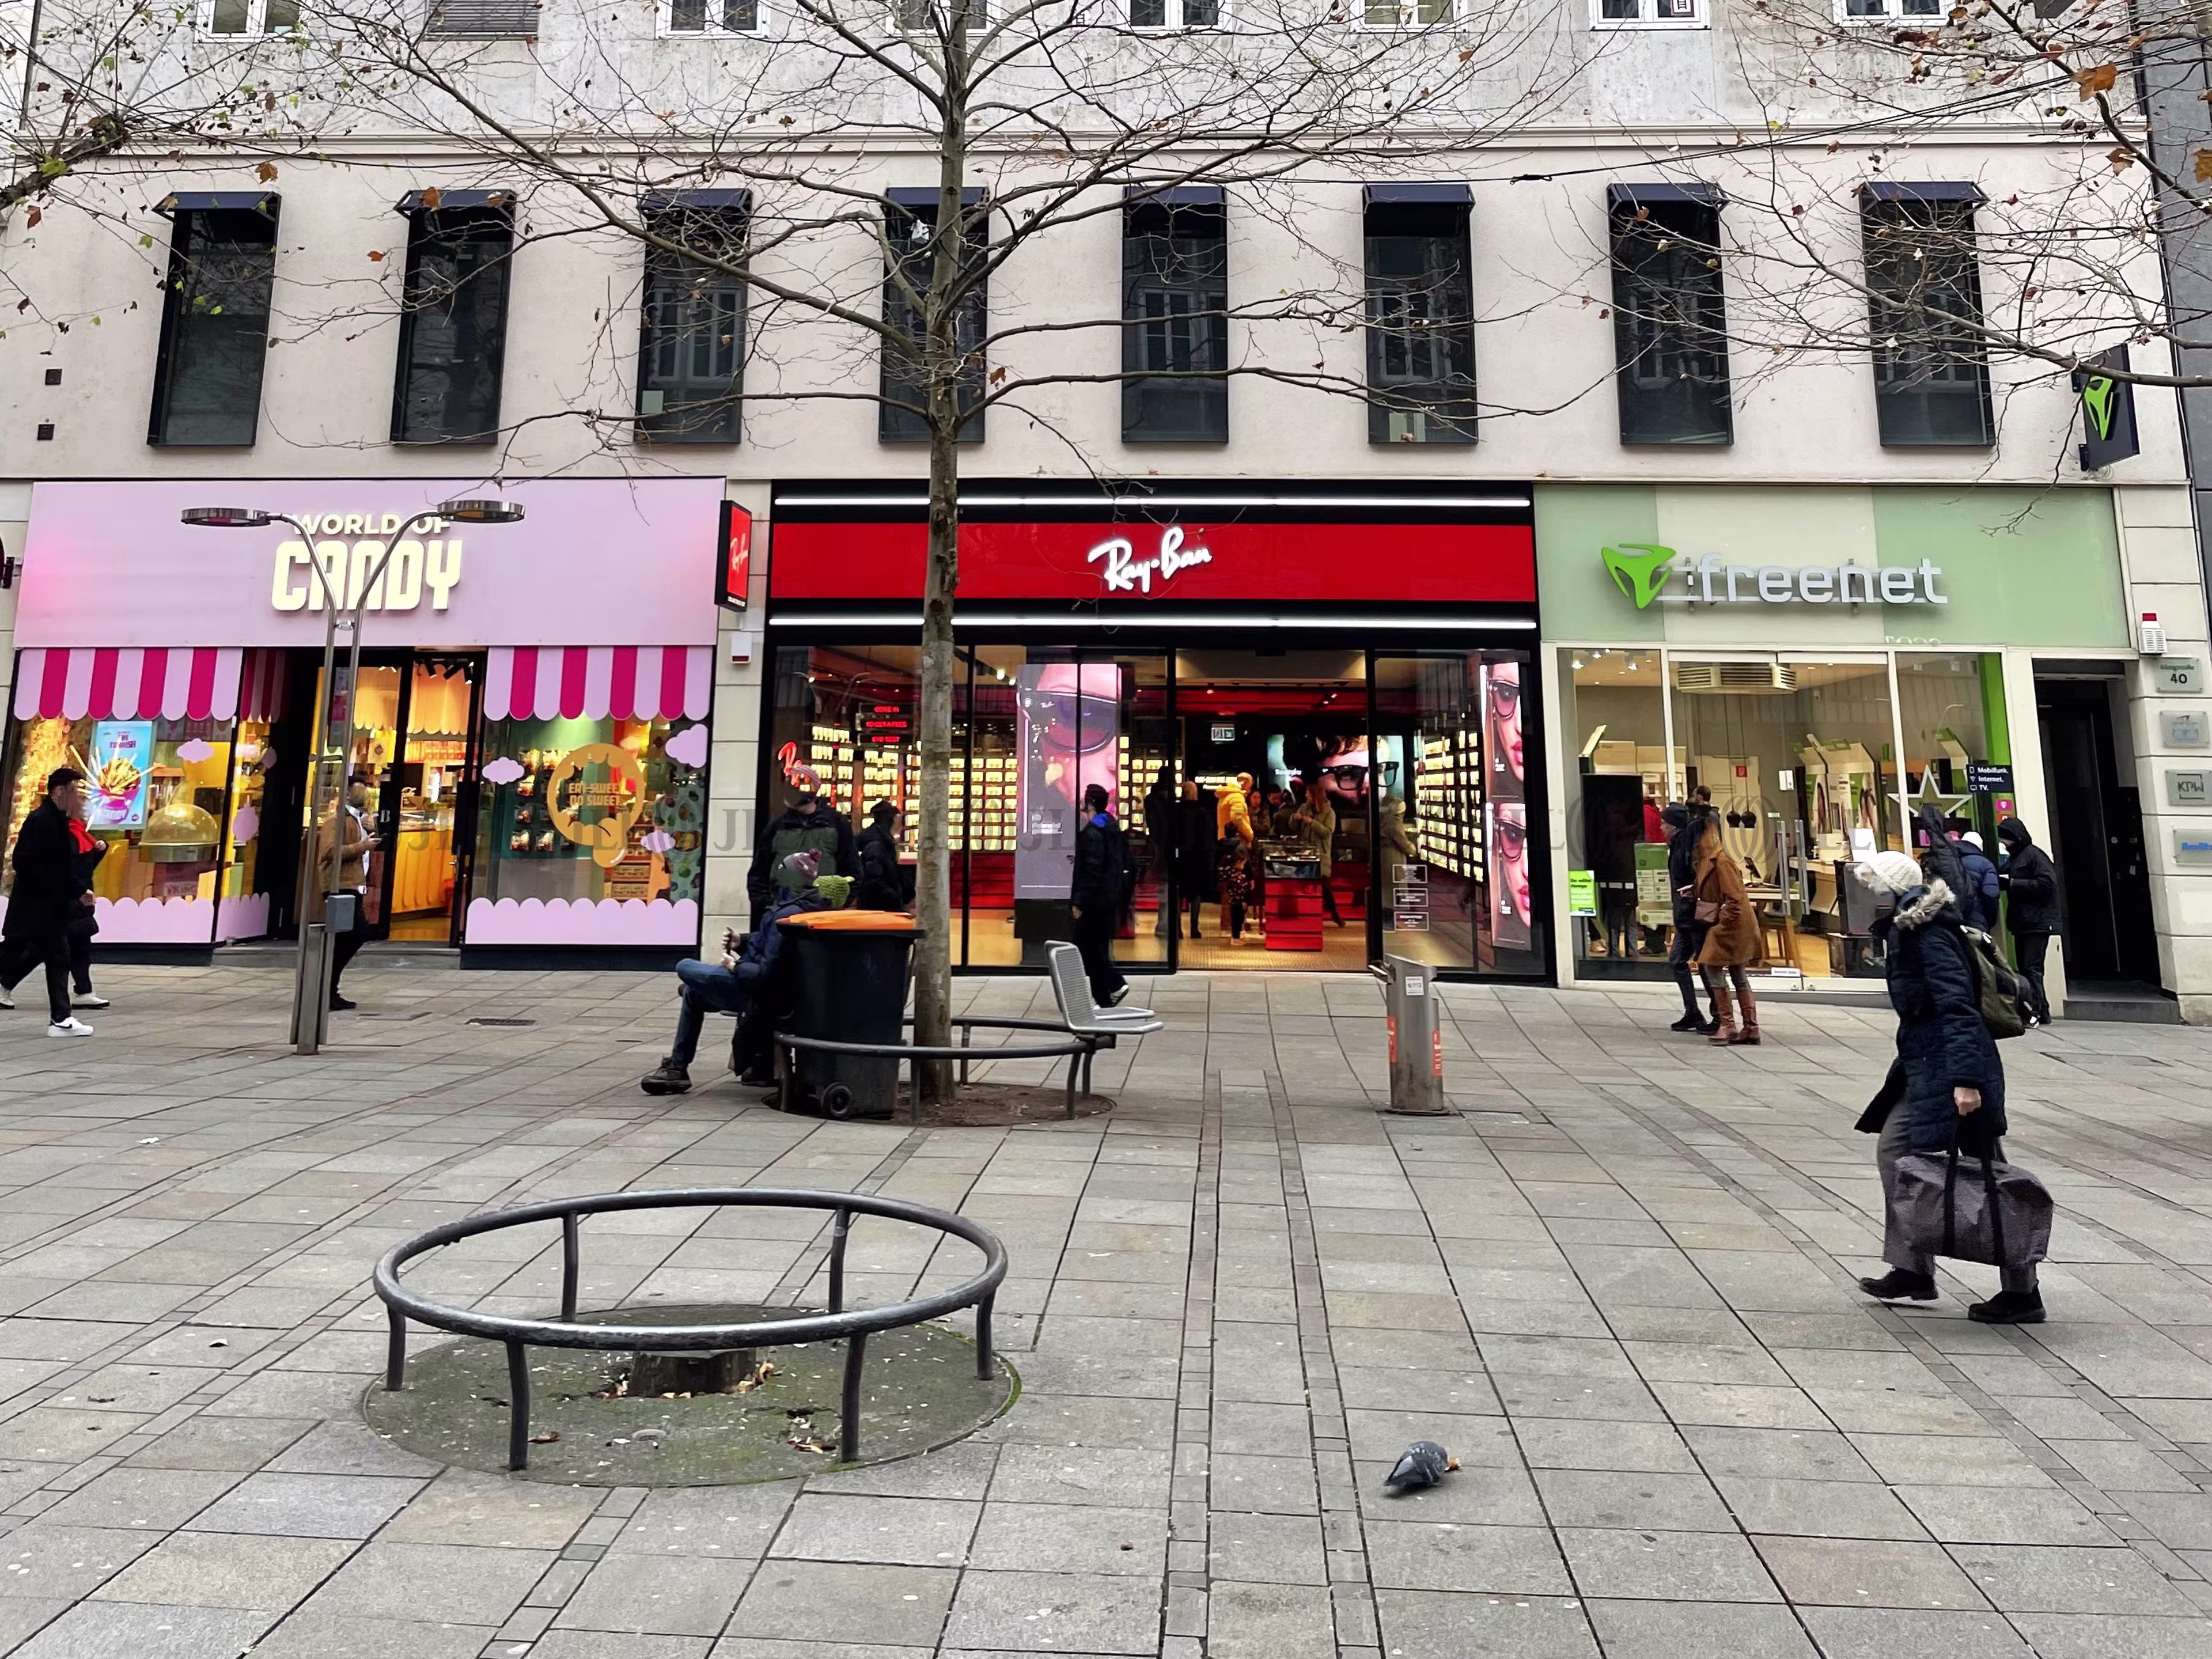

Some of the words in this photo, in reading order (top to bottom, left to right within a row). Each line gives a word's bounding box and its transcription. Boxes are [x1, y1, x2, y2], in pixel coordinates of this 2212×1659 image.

[293, 513, 402, 535] WORLD
[411, 514, 451, 535] OF
[271, 539, 463, 611] CANDY
[1087, 525, 1213, 593] Ray-Ban
[1696, 552, 1948, 604] freenet
[2171, 673, 2188, 684] 40
[2177, 781, 2205, 793] KPW
